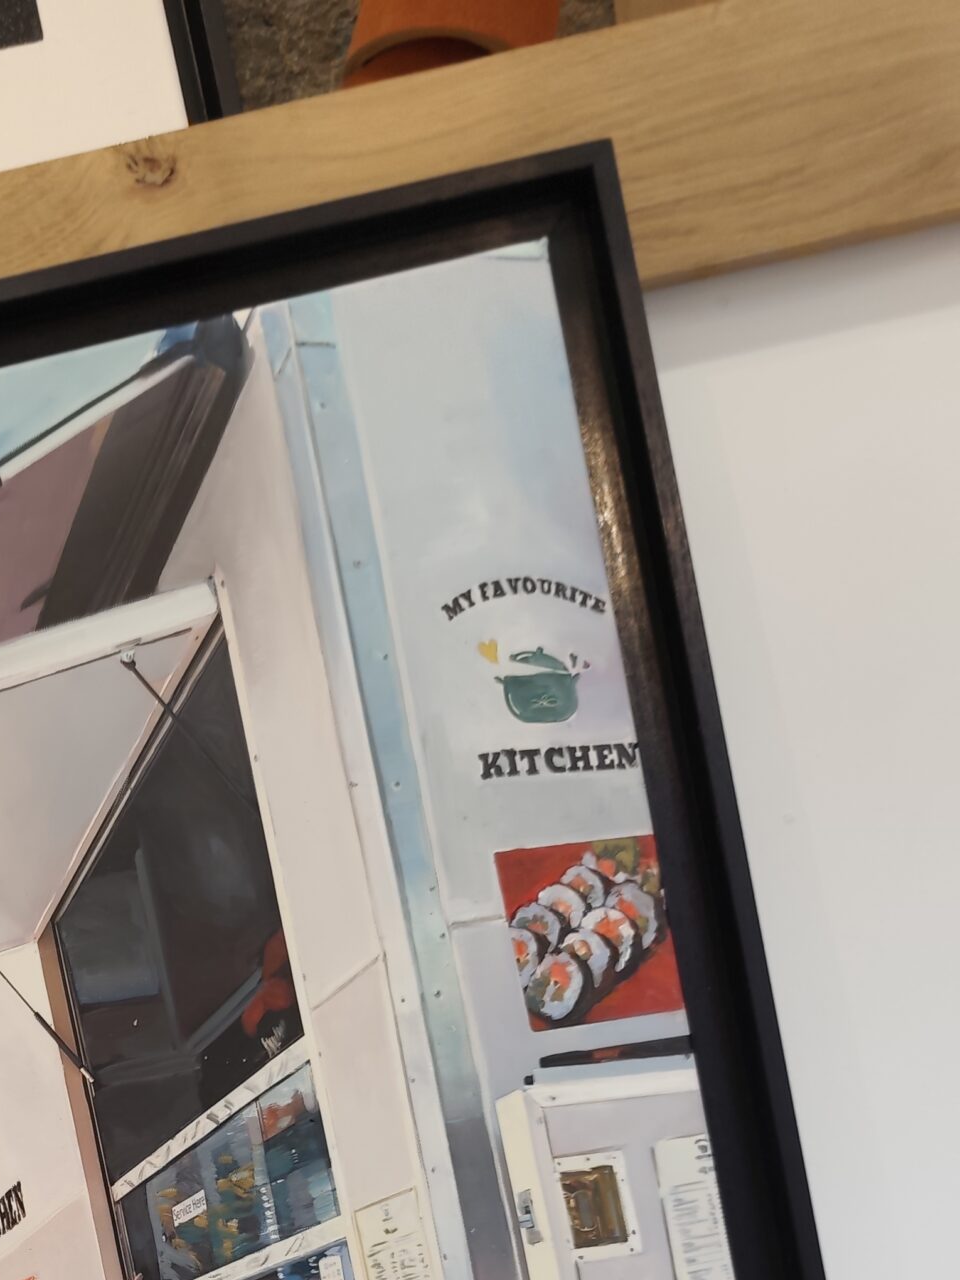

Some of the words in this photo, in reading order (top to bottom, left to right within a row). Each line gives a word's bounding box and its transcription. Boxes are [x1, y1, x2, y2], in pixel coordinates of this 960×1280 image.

[441, 589, 476, 621] MY
[478, 576, 606, 614] FAVOURITE
[478, 741, 639, 780] KITCHEN
[191, 1195, 205, 1210] Here
